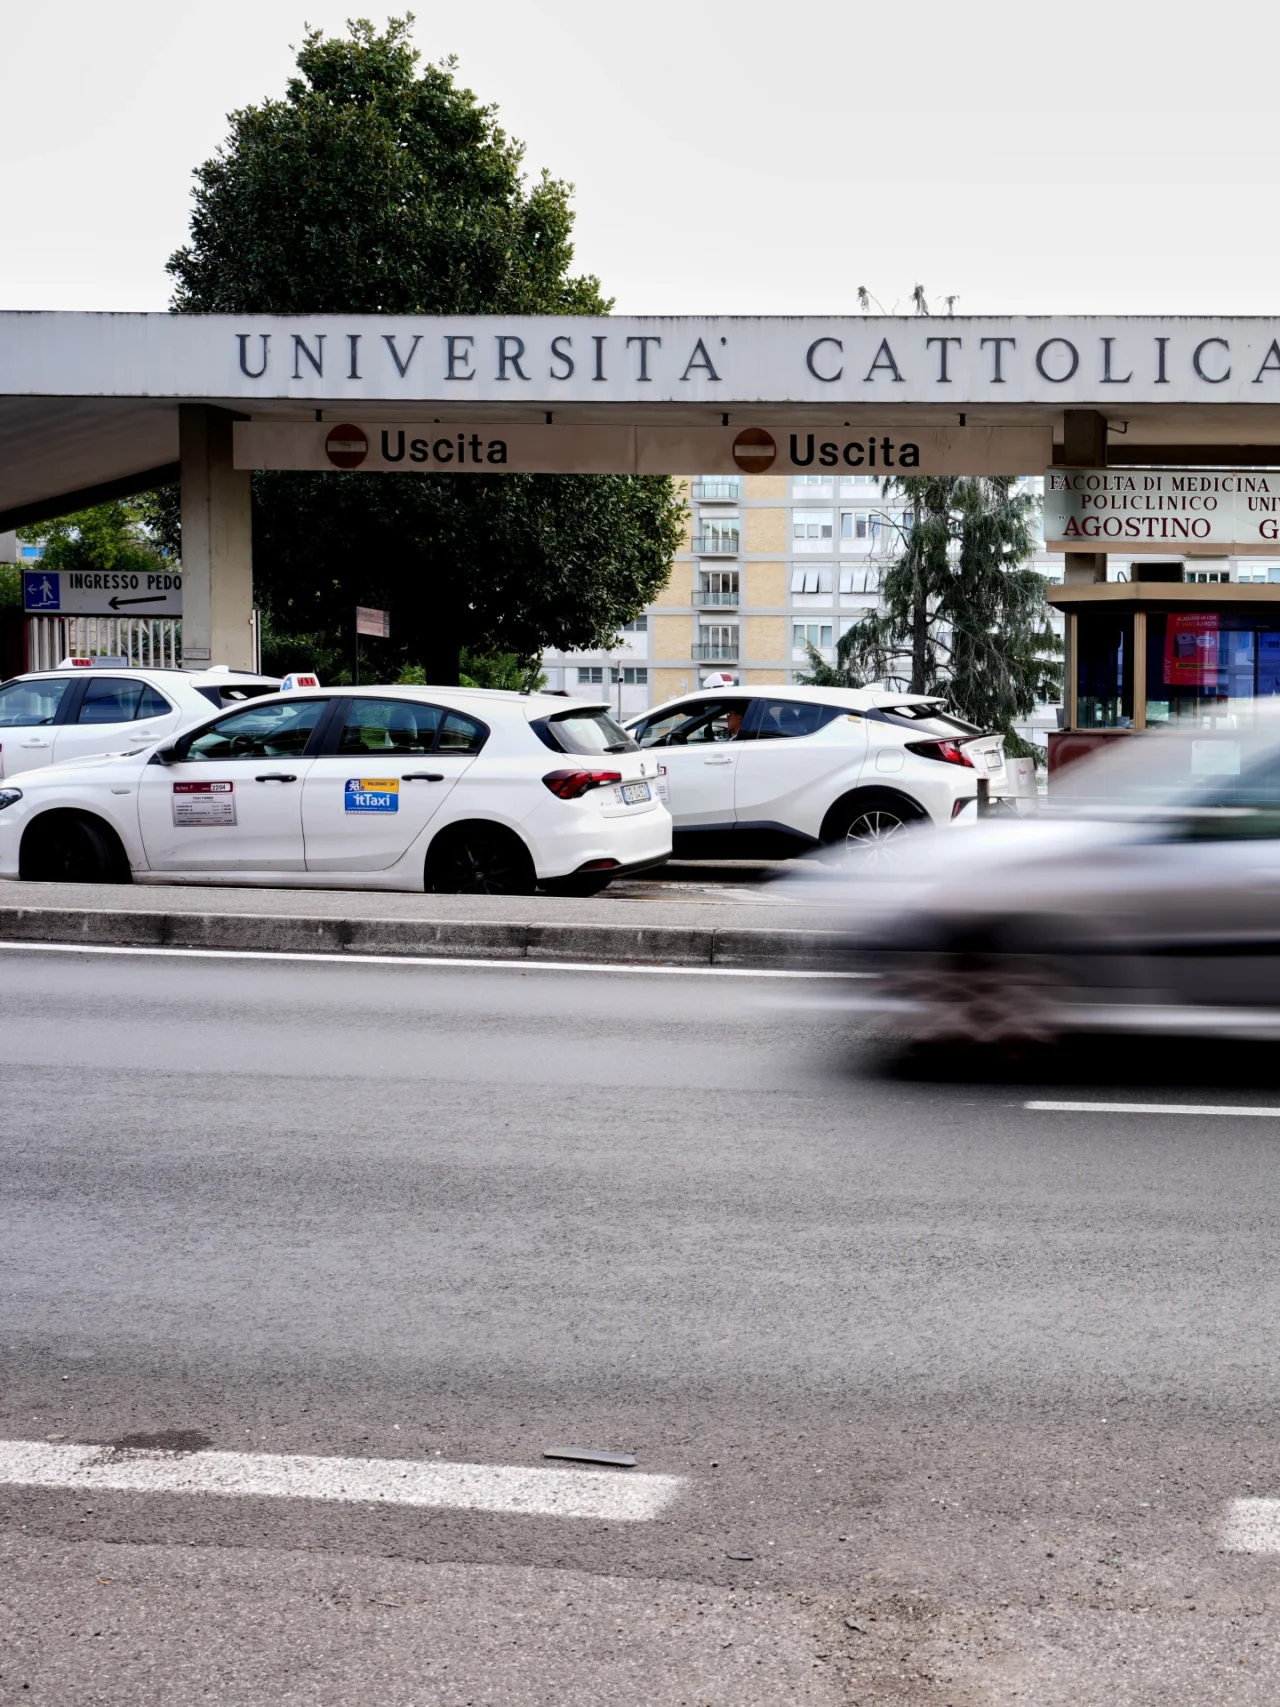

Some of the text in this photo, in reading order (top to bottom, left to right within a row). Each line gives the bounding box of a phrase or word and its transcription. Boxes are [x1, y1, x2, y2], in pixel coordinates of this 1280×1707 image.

[235, 334, 727, 381] UNIVERSITA'
[381, 430, 508, 464] Uscita
[790, 434, 921, 468] Uscita
[1143, 477, 1162, 491] DI
[1171, 477, 1270, 493] MEDICINA
[1080, 494, 1218, 511] POLICLINICO
[69, 573, 139, 590] INGRESSO
[353, 793, 390, 807] itTaxi
